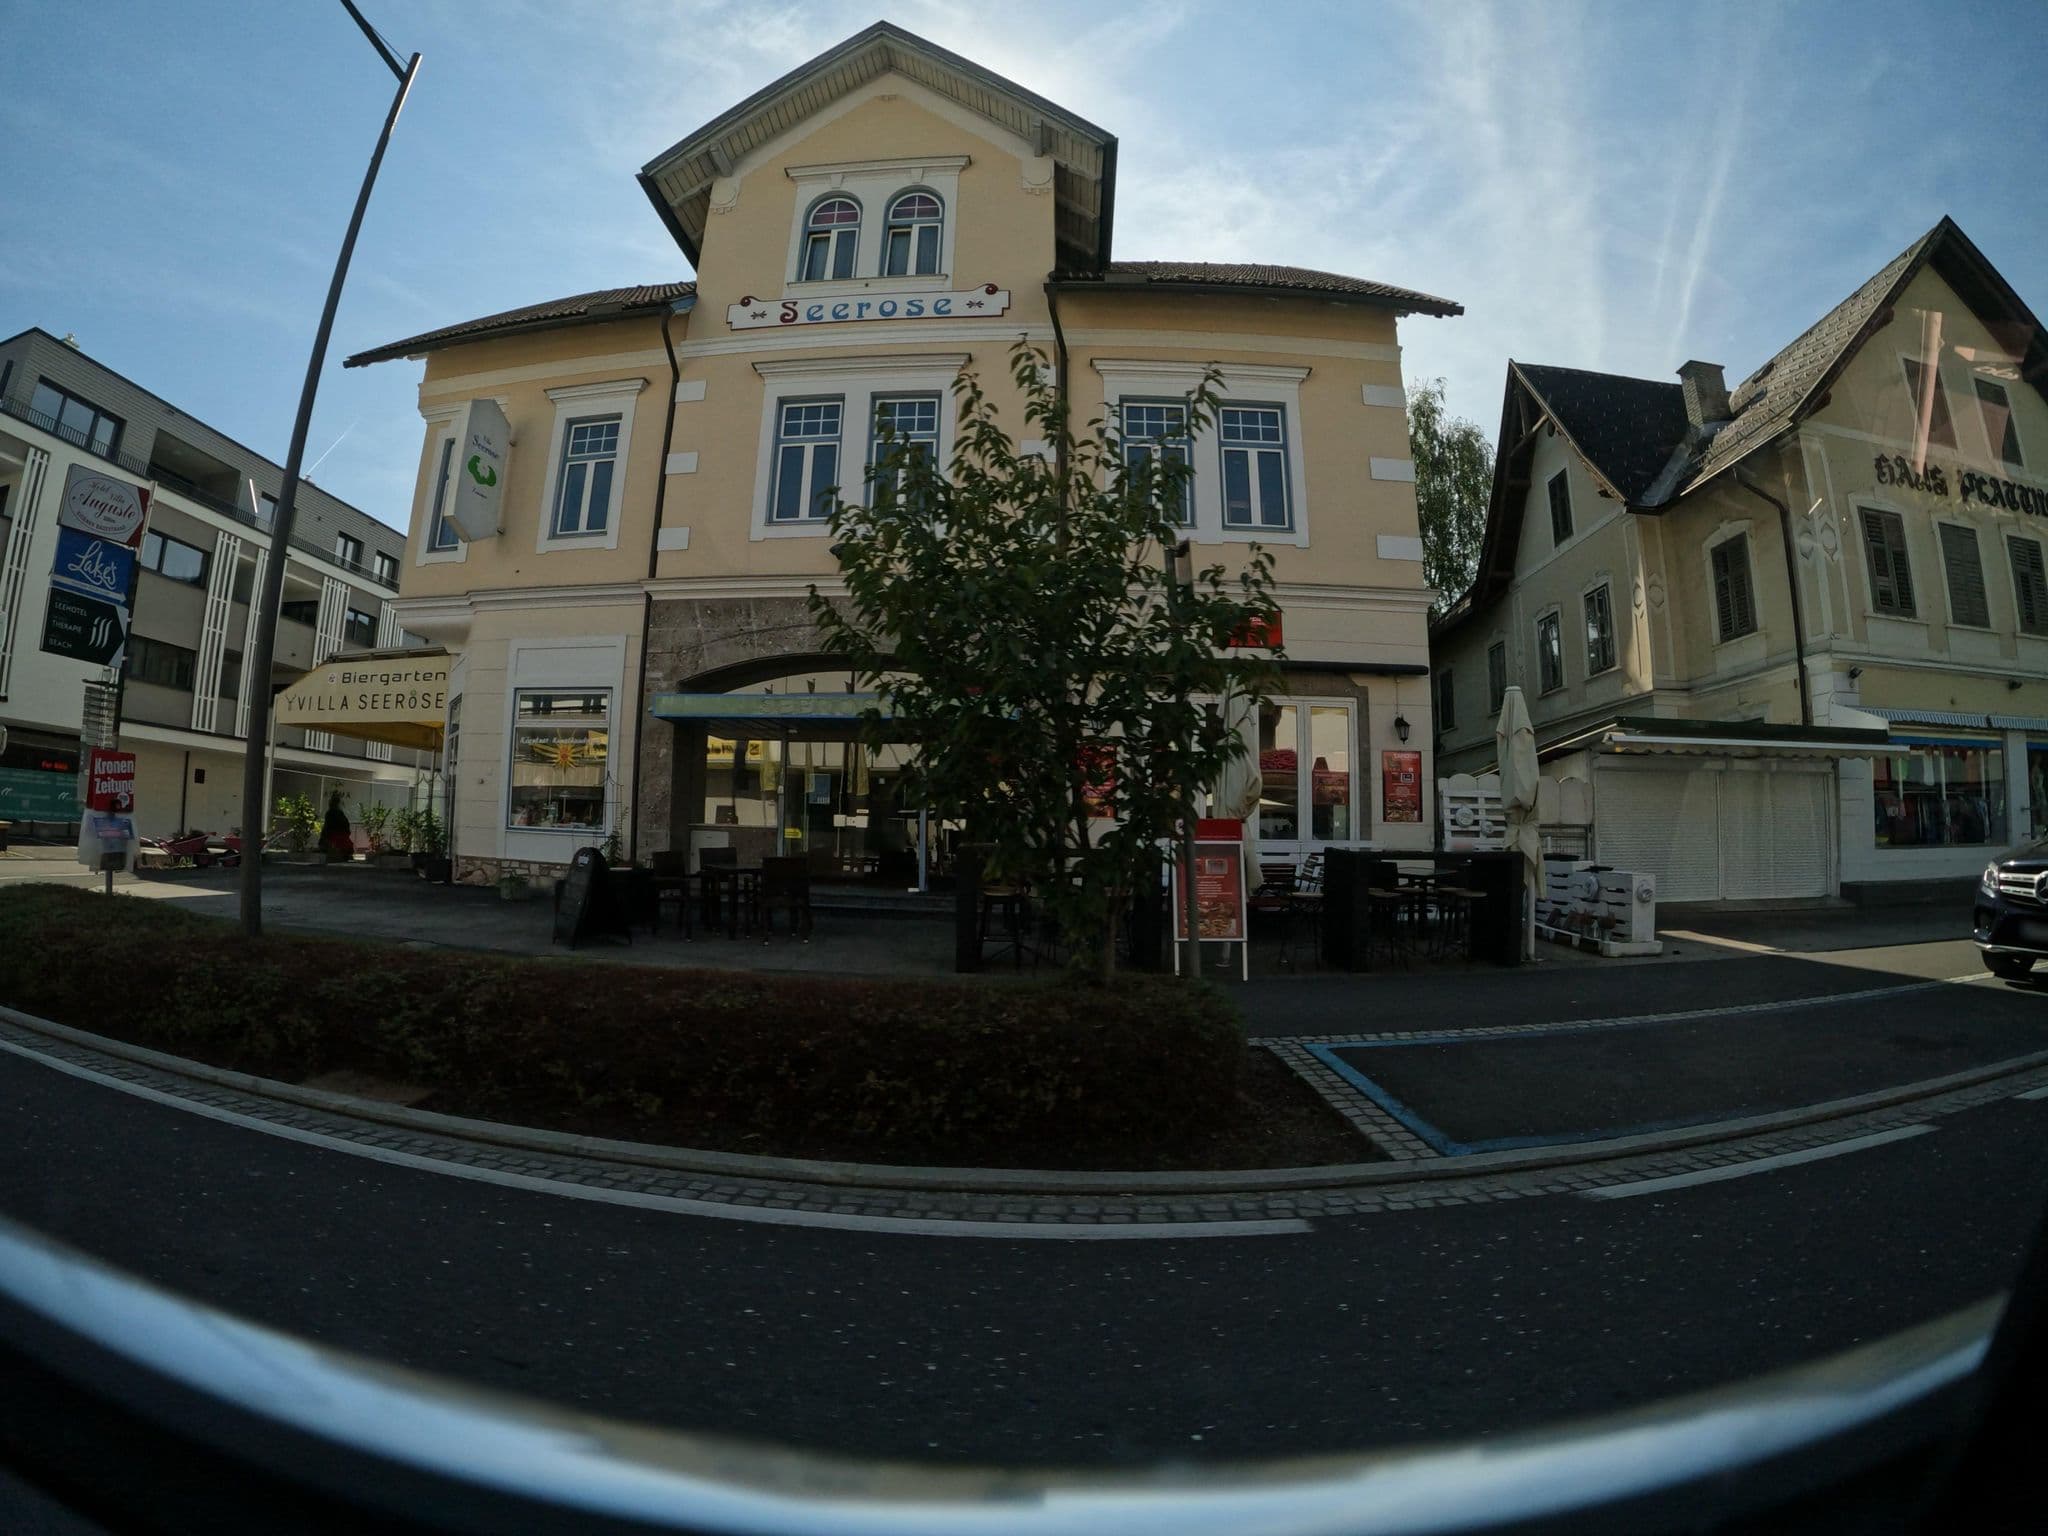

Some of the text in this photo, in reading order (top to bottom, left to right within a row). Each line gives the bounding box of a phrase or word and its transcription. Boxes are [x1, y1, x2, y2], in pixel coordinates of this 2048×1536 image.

[779, 298, 952, 324] Seerose
[72, 489, 136, 519] Auguste
[55, 602, 87, 616] SEEHOTEL
[342, 671, 446, 686] Biergarten
[298, 695, 349, 711] VILLA
[95, 758, 134, 775] Kronen
[94, 777, 135, 795] Zeitung
